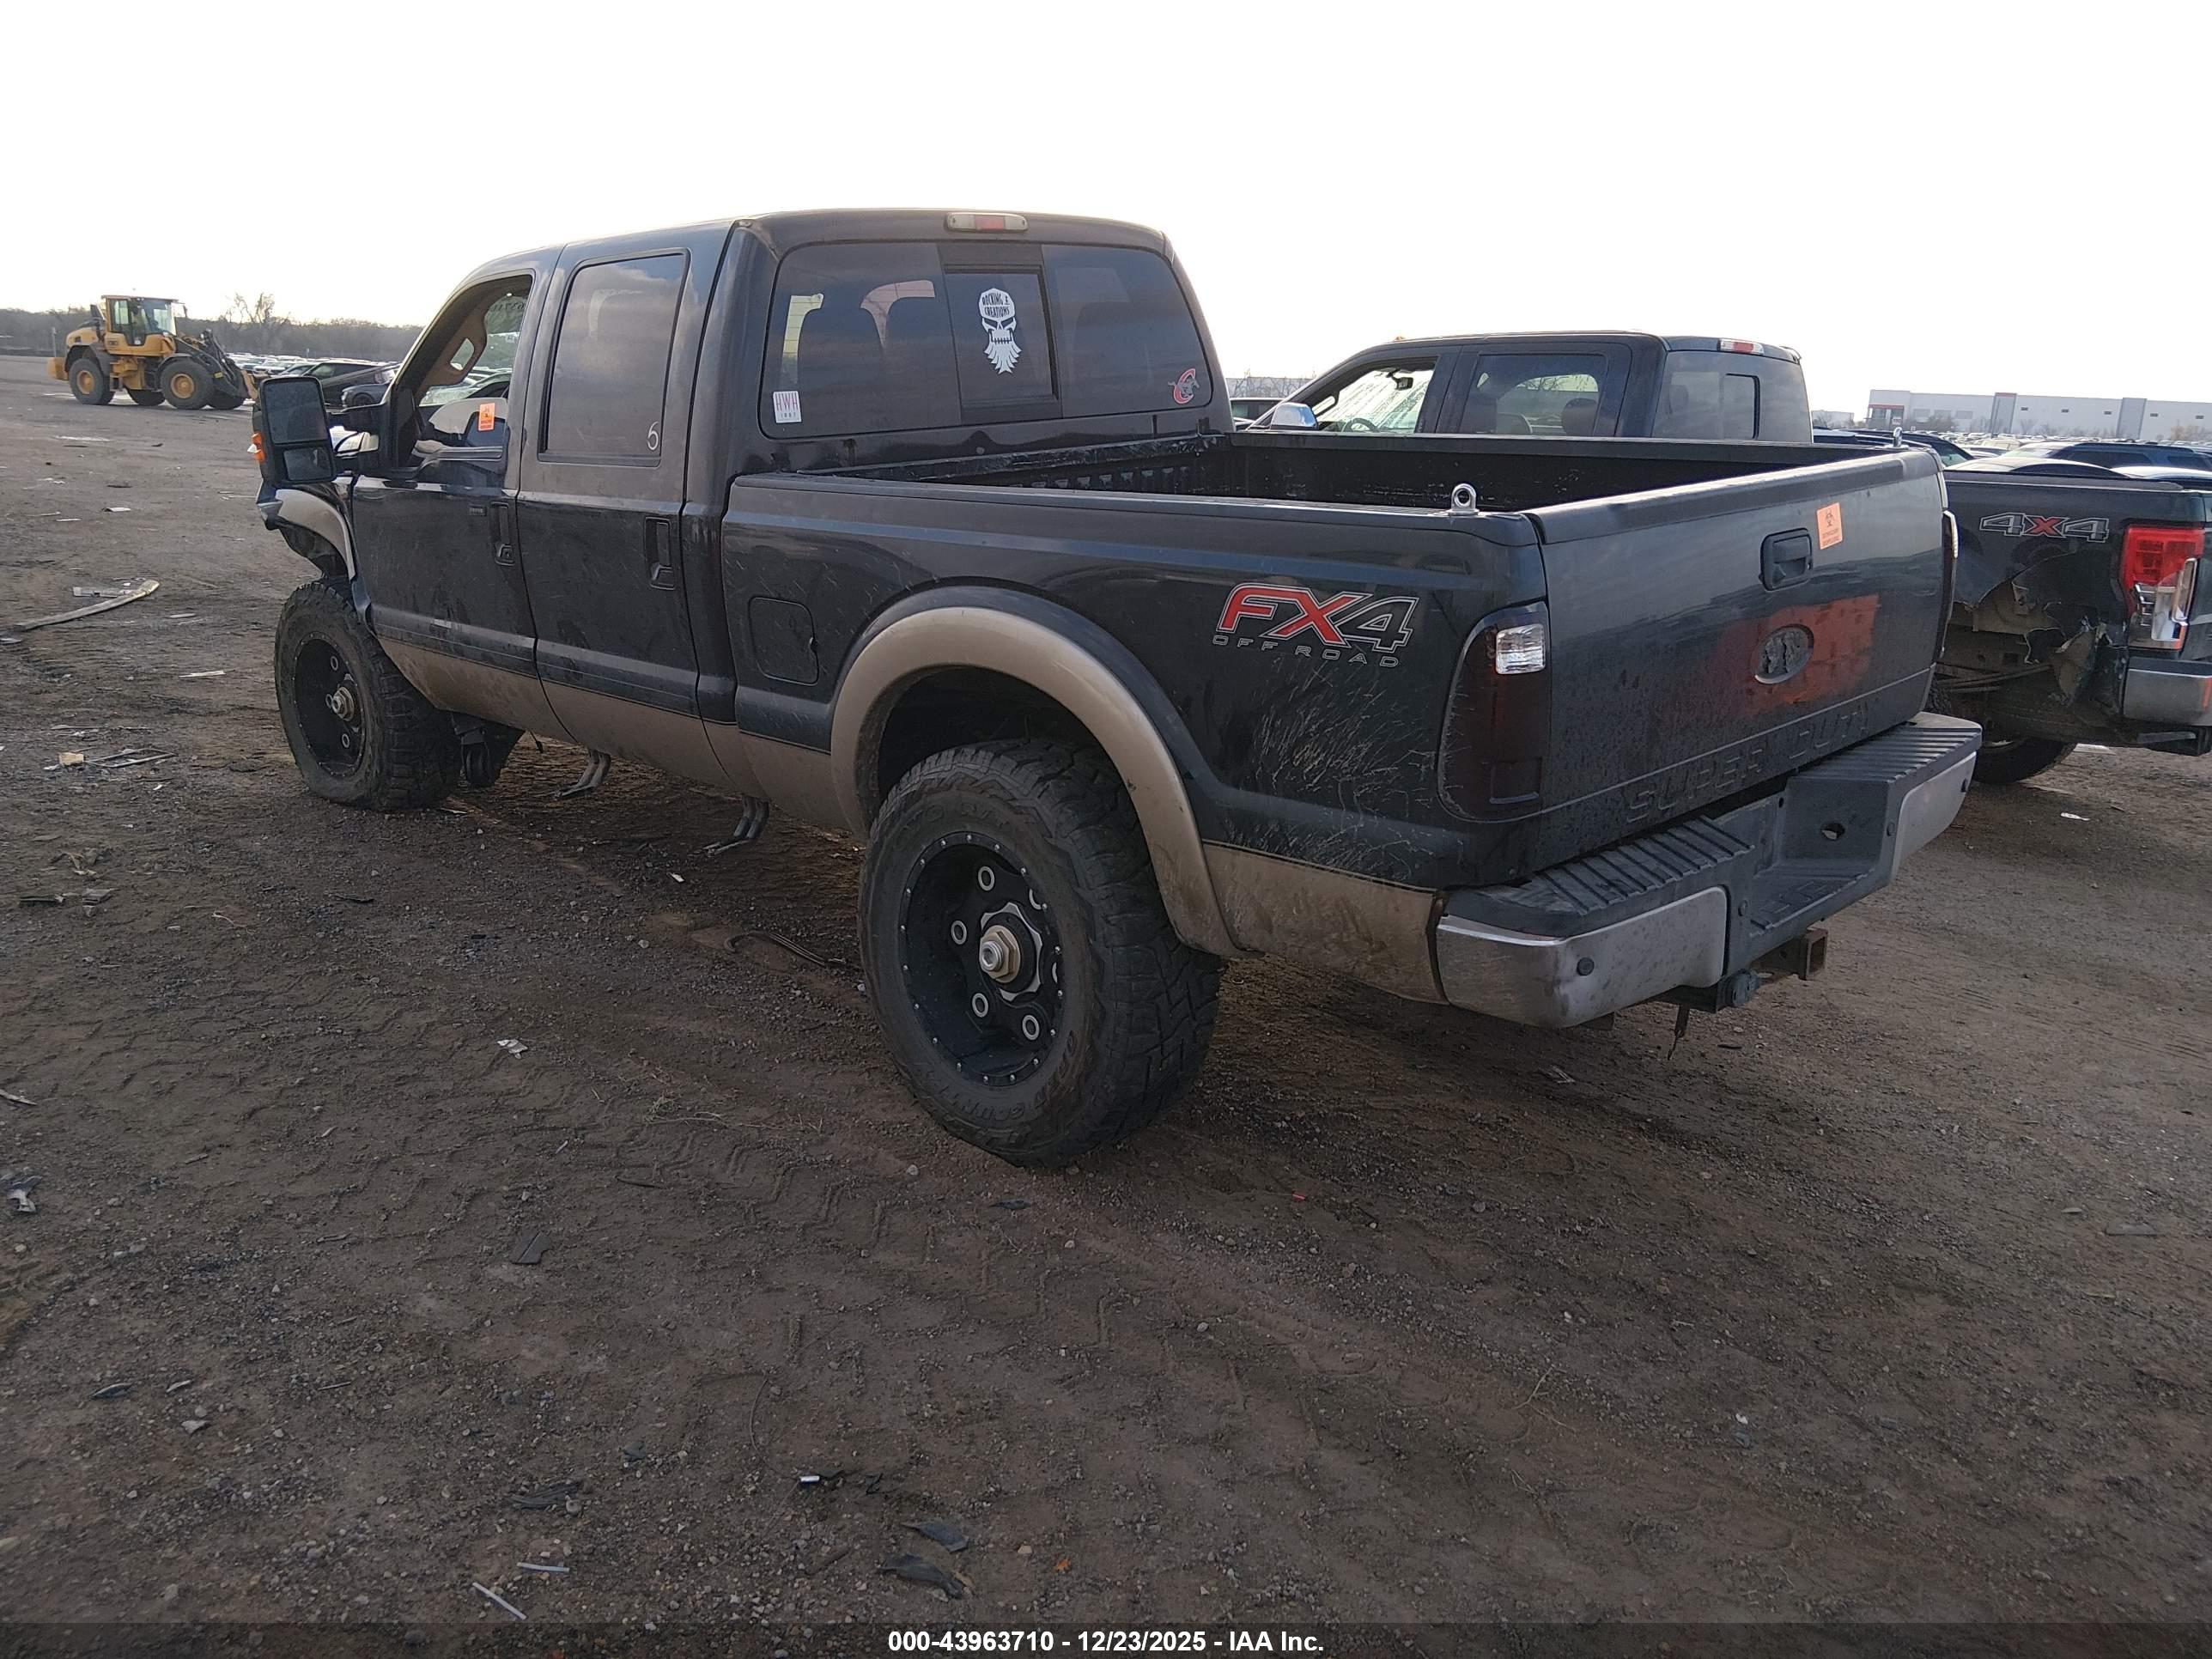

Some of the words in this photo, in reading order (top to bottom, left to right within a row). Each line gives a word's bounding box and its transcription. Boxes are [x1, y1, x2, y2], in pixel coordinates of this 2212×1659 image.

[984, 306, 1010, 318] CREATIONS
[1216, 582, 1420, 653] FX4
[1212, 635, 1279, 651] OFF
[1295, 645, 1400, 668] ROAD
[1626, 738, 1770, 823] SUPER
